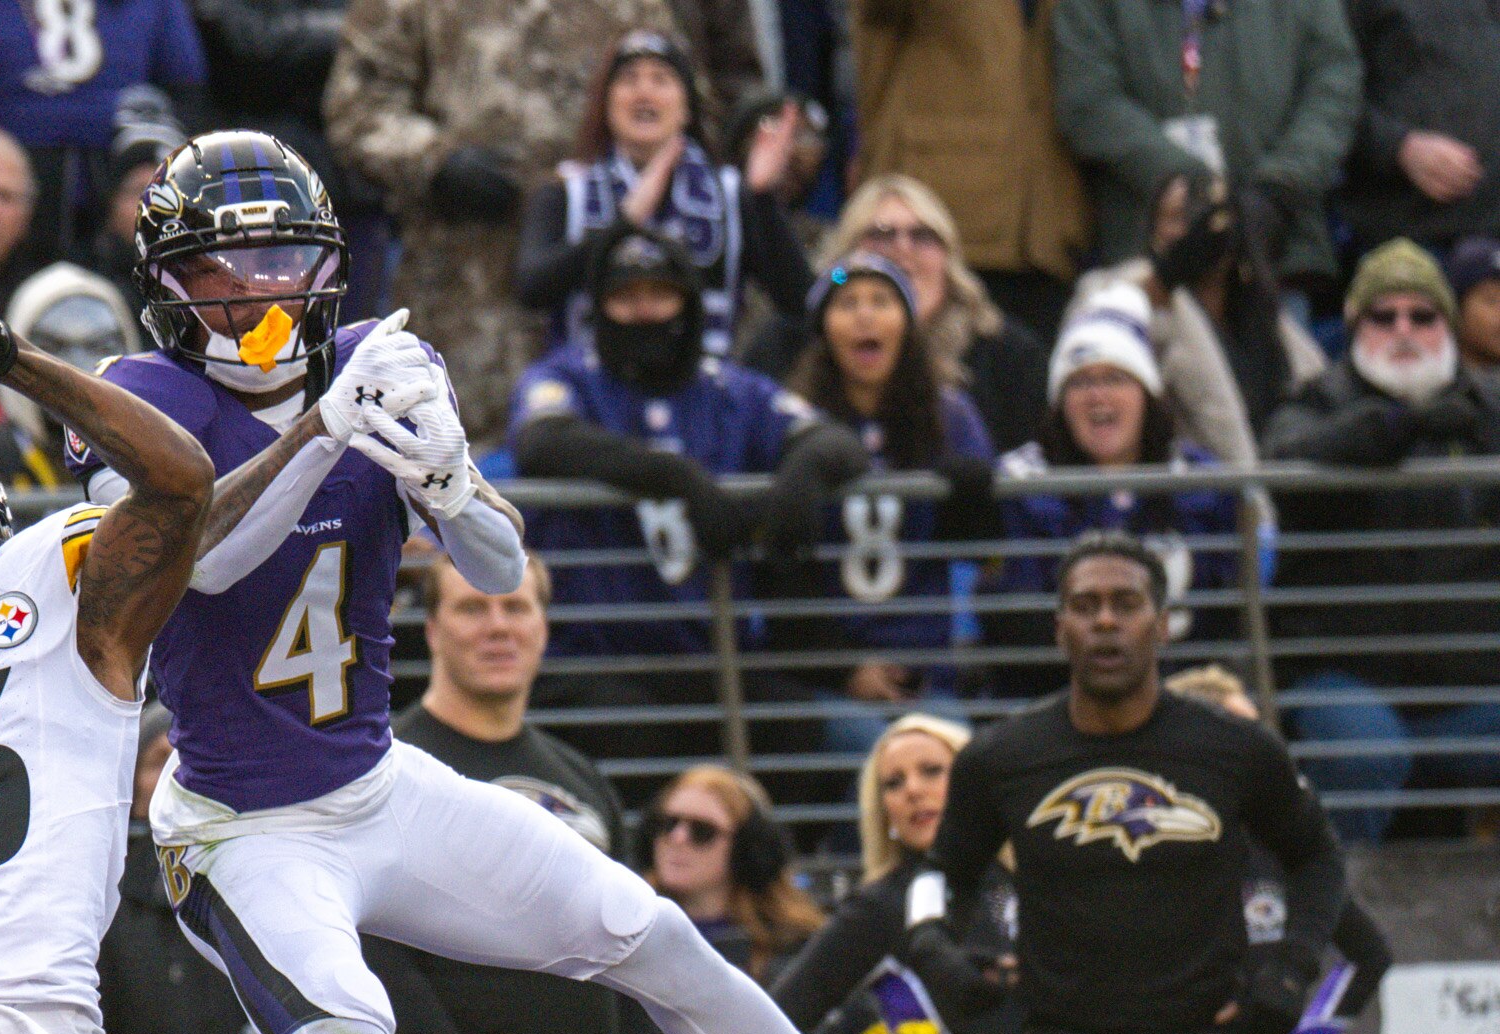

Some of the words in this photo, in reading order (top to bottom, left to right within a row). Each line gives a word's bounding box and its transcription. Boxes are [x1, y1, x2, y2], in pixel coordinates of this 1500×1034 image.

[292, 518, 342, 535] AVENS
[840, 493, 905, 603] 8
[253, 540, 359, 727] 4
